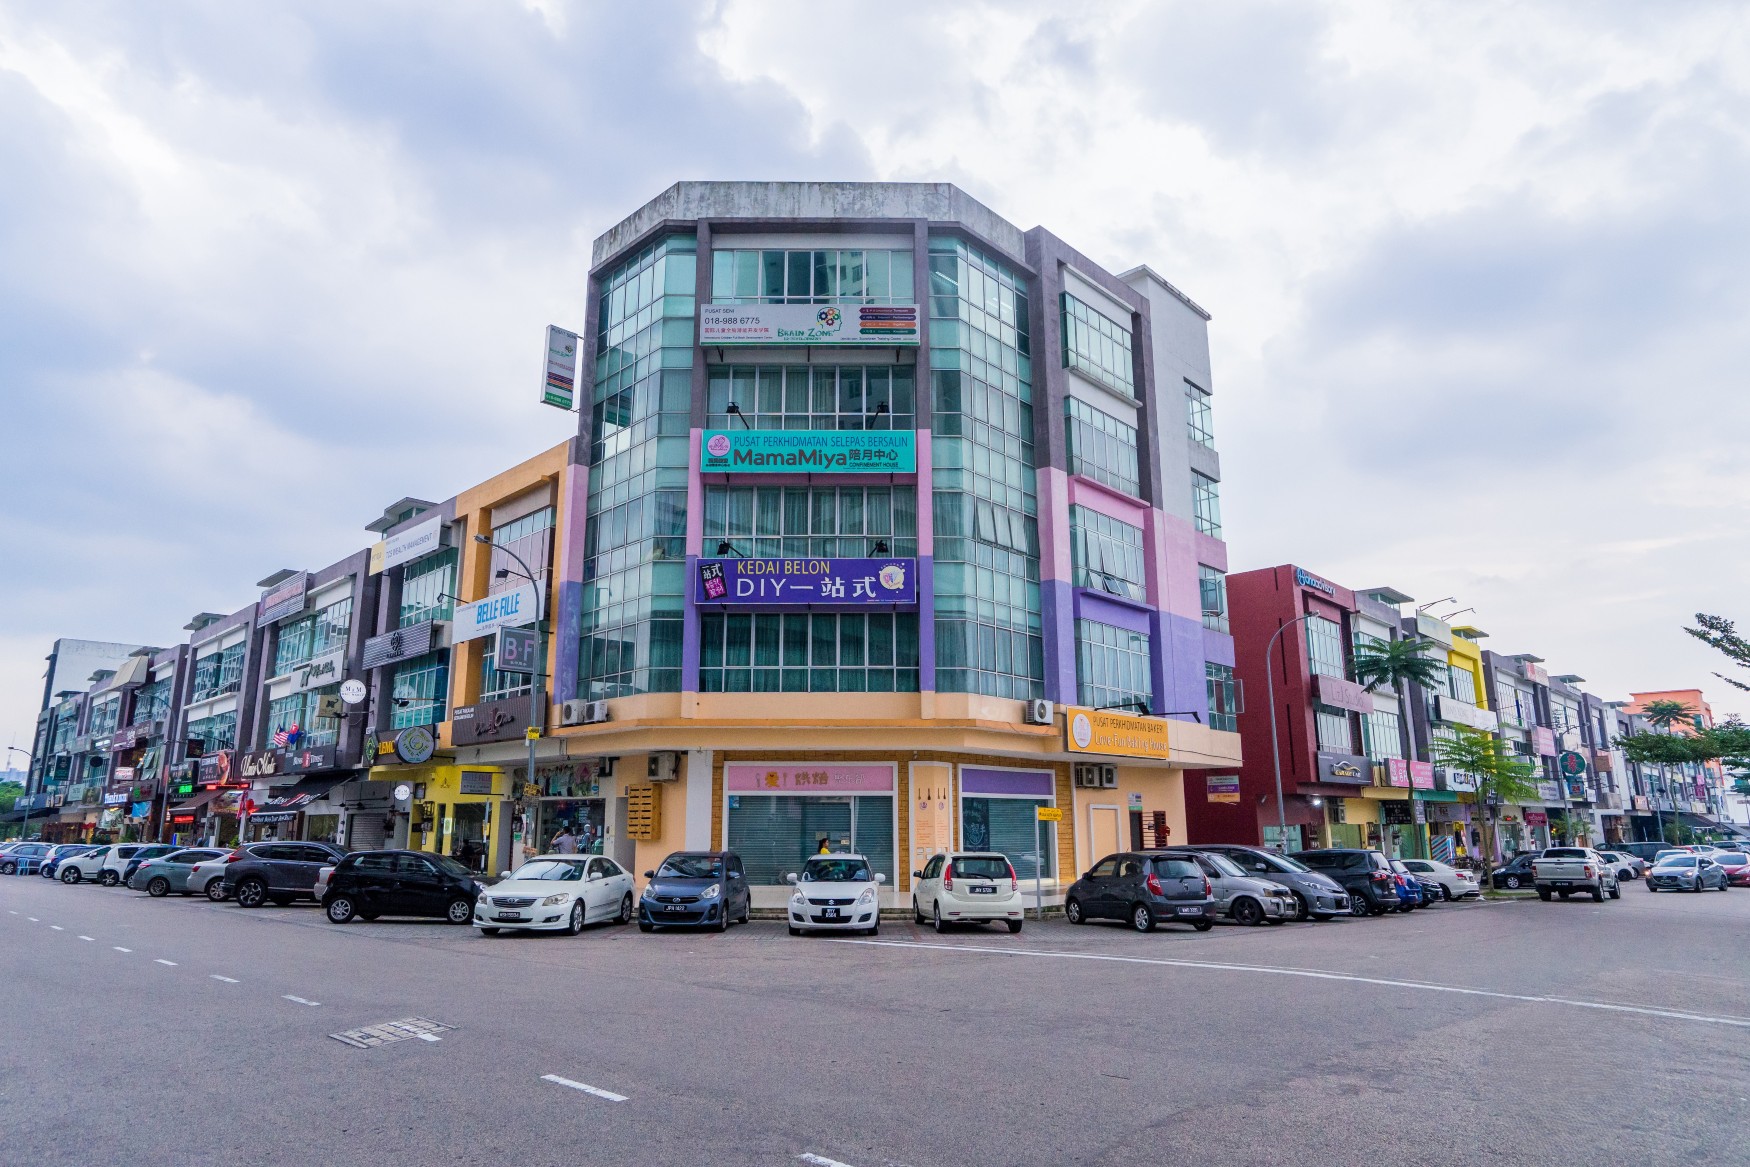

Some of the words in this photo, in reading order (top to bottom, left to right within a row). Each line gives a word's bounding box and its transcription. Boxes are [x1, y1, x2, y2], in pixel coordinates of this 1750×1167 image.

[777, 328, 804, 337] BRAIN
[808, 328, 833, 337] ZONE
[734, 436, 760, 446] PUSAT
[764, 436, 827, 447] PERKHIDMATAN
[831, 436, 865, 447] SELEPAS
[868, 436, 908, 447] BERSALIN
[733, 449, 847, 469] MamaMiya
[849, 449, 899, 460] 陪月中心
[737, 561, 779, 575] KEDAI
[784, 561, 830, 575] BELON
[476, 600, 498, 624] BELLE
[500, 593, 520, 617] FILLE
[1110, 719, 1146, 732] PERKHIDMATAN
